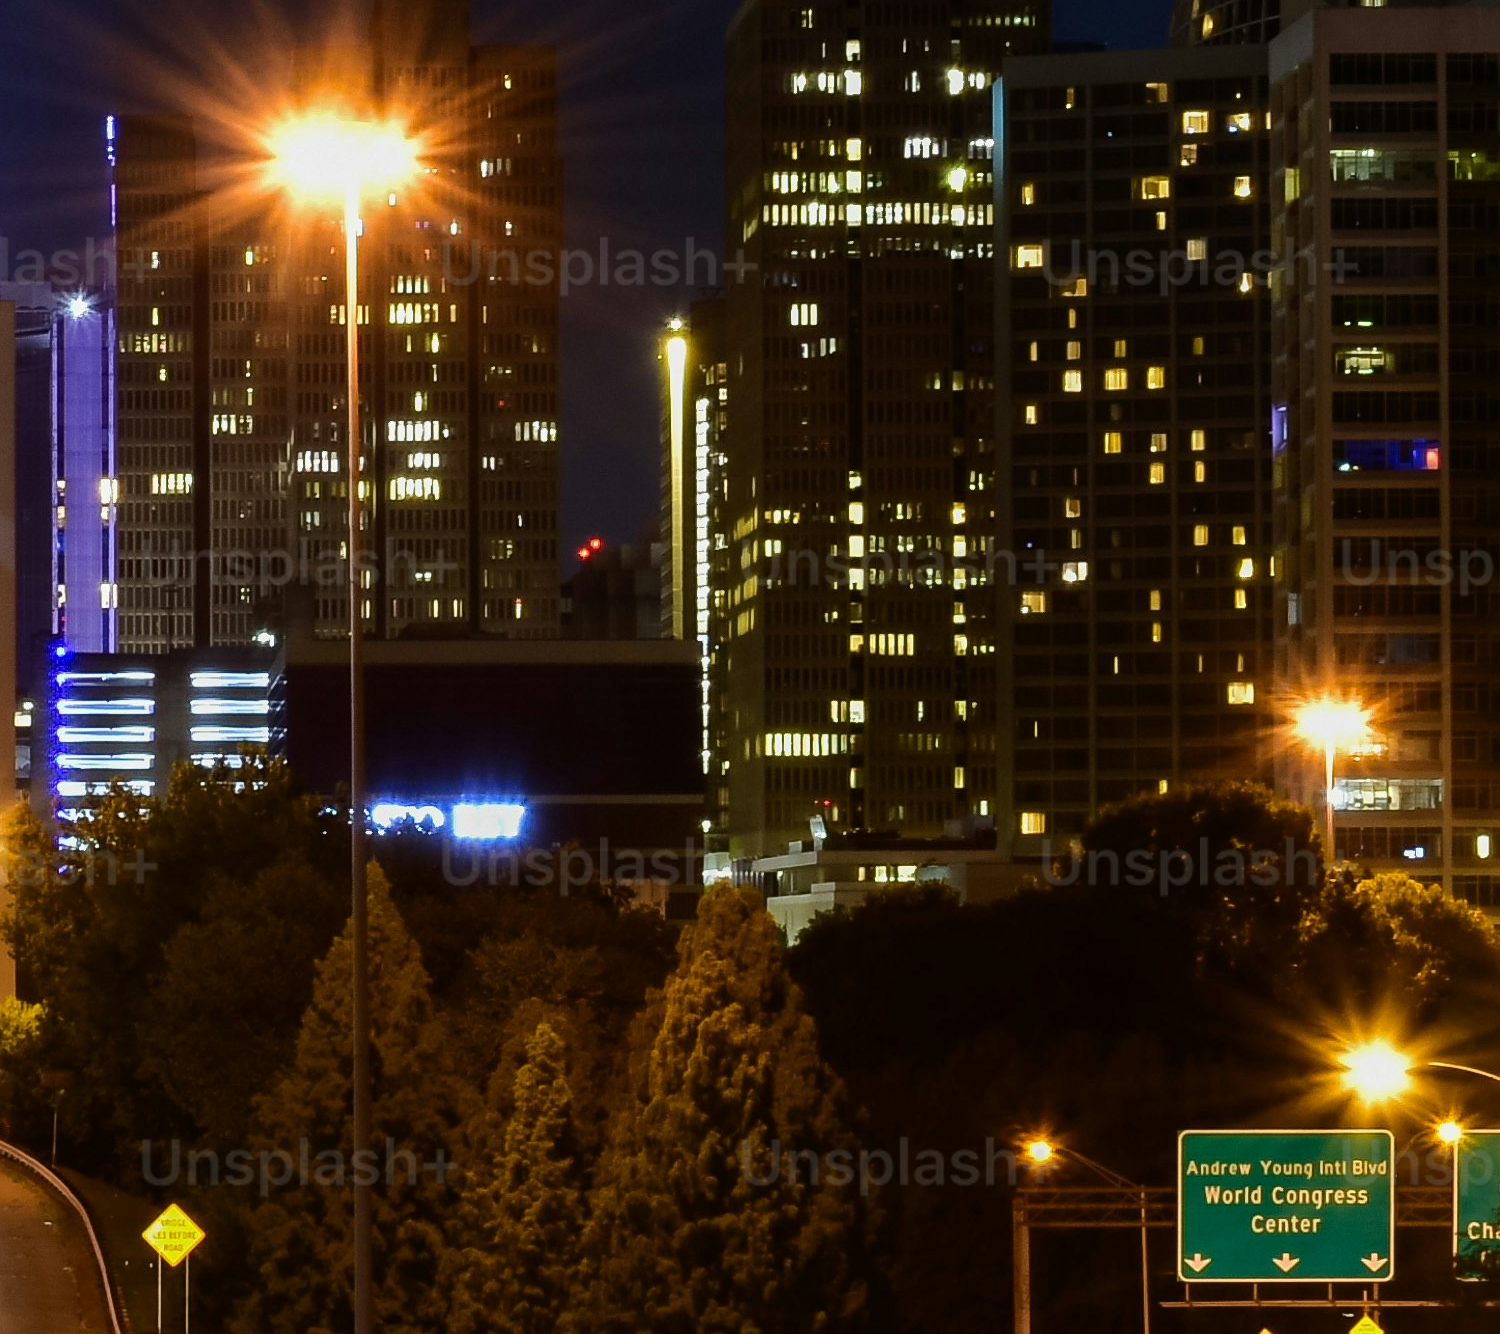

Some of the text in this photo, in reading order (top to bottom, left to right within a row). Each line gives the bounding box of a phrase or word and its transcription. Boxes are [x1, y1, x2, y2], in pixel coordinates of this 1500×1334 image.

[1186, 1159, 1387, 1179] Andrew Young Intl Blvd
[1204, 1186, 1368, 1210] World Congress
[1251, 1215, 1321, 1233] Center
